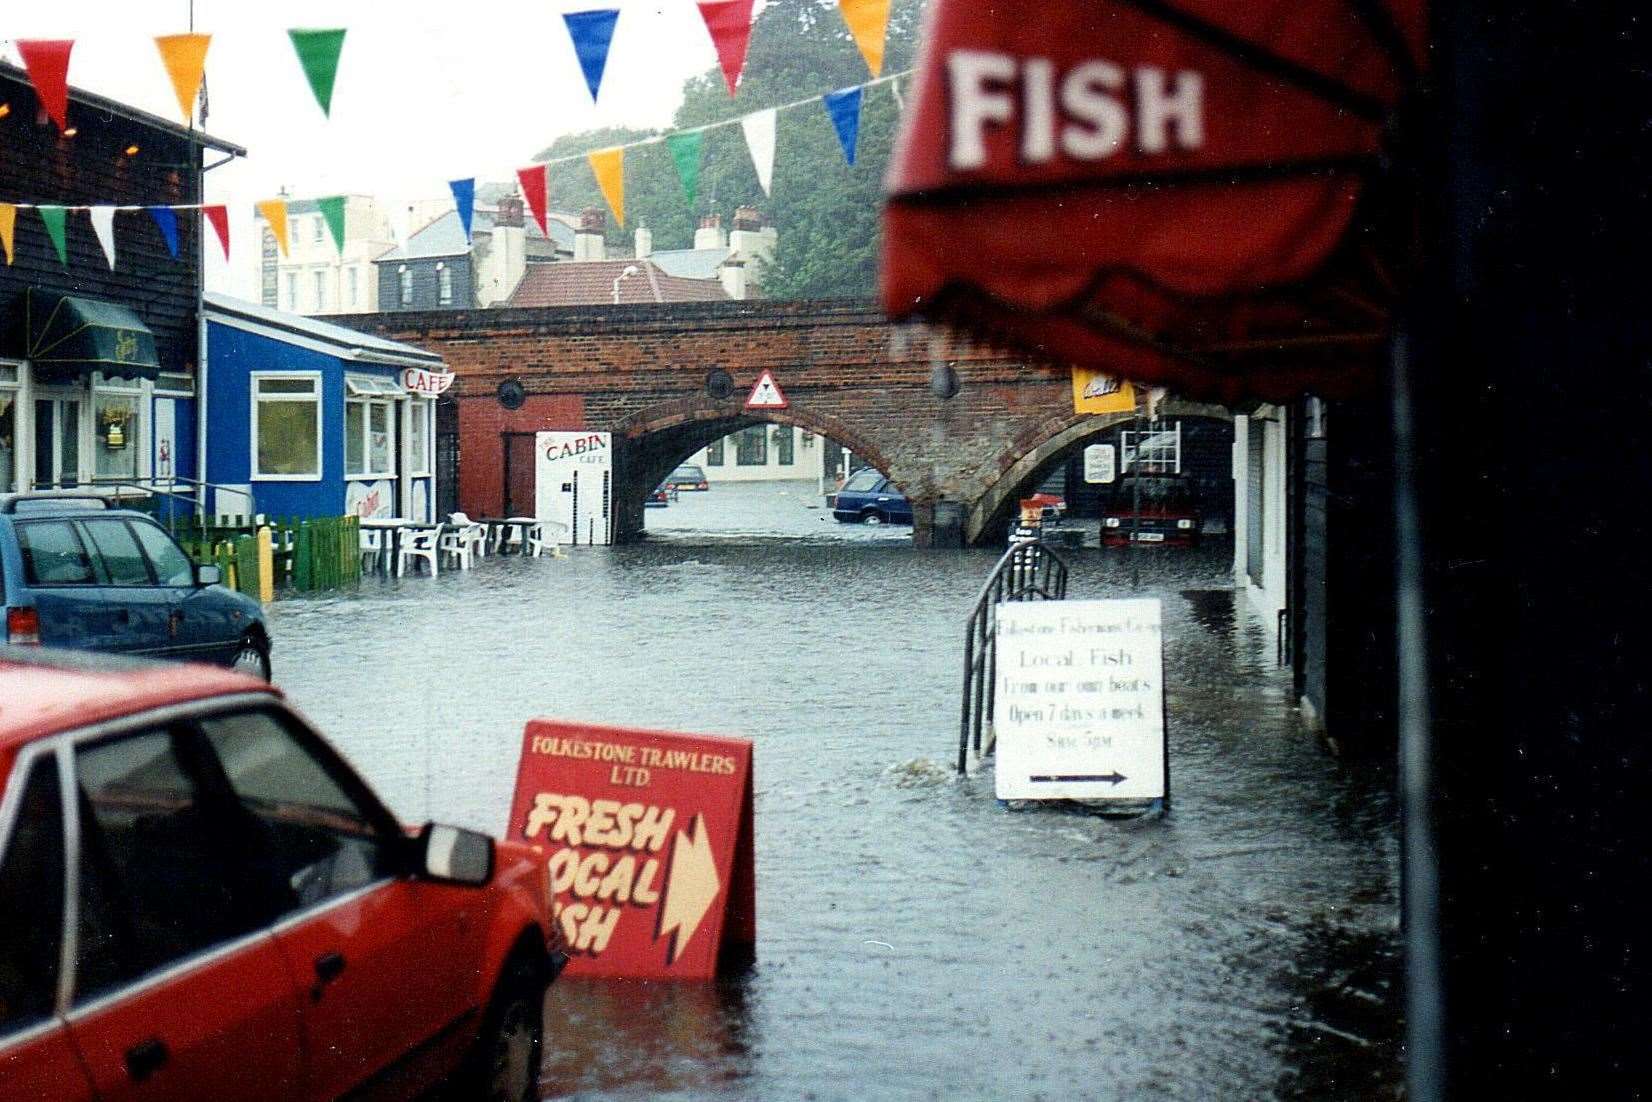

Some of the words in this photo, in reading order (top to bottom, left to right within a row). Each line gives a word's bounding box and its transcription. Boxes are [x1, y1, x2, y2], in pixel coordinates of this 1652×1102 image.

[947, 50, 1206, 171] FISH
[404, 368, 448, 392] CAFE
[546, 434, 607, 461] CABIN
[1020, 650, 1073, 668] Local
[1090, 648, 1132, 666] Fish
[1008, 703, 1044, 725] Open
[531, 735, 638, 764] FOLKESTONE
[640, 746, 736, 775] TRAWLERS
[610, 765, 651, 788] LTD
[524, 792, 676, 851] FRESH
[547, 847, 659, 904] OCAL
[554, 902, 621, 954] SH
